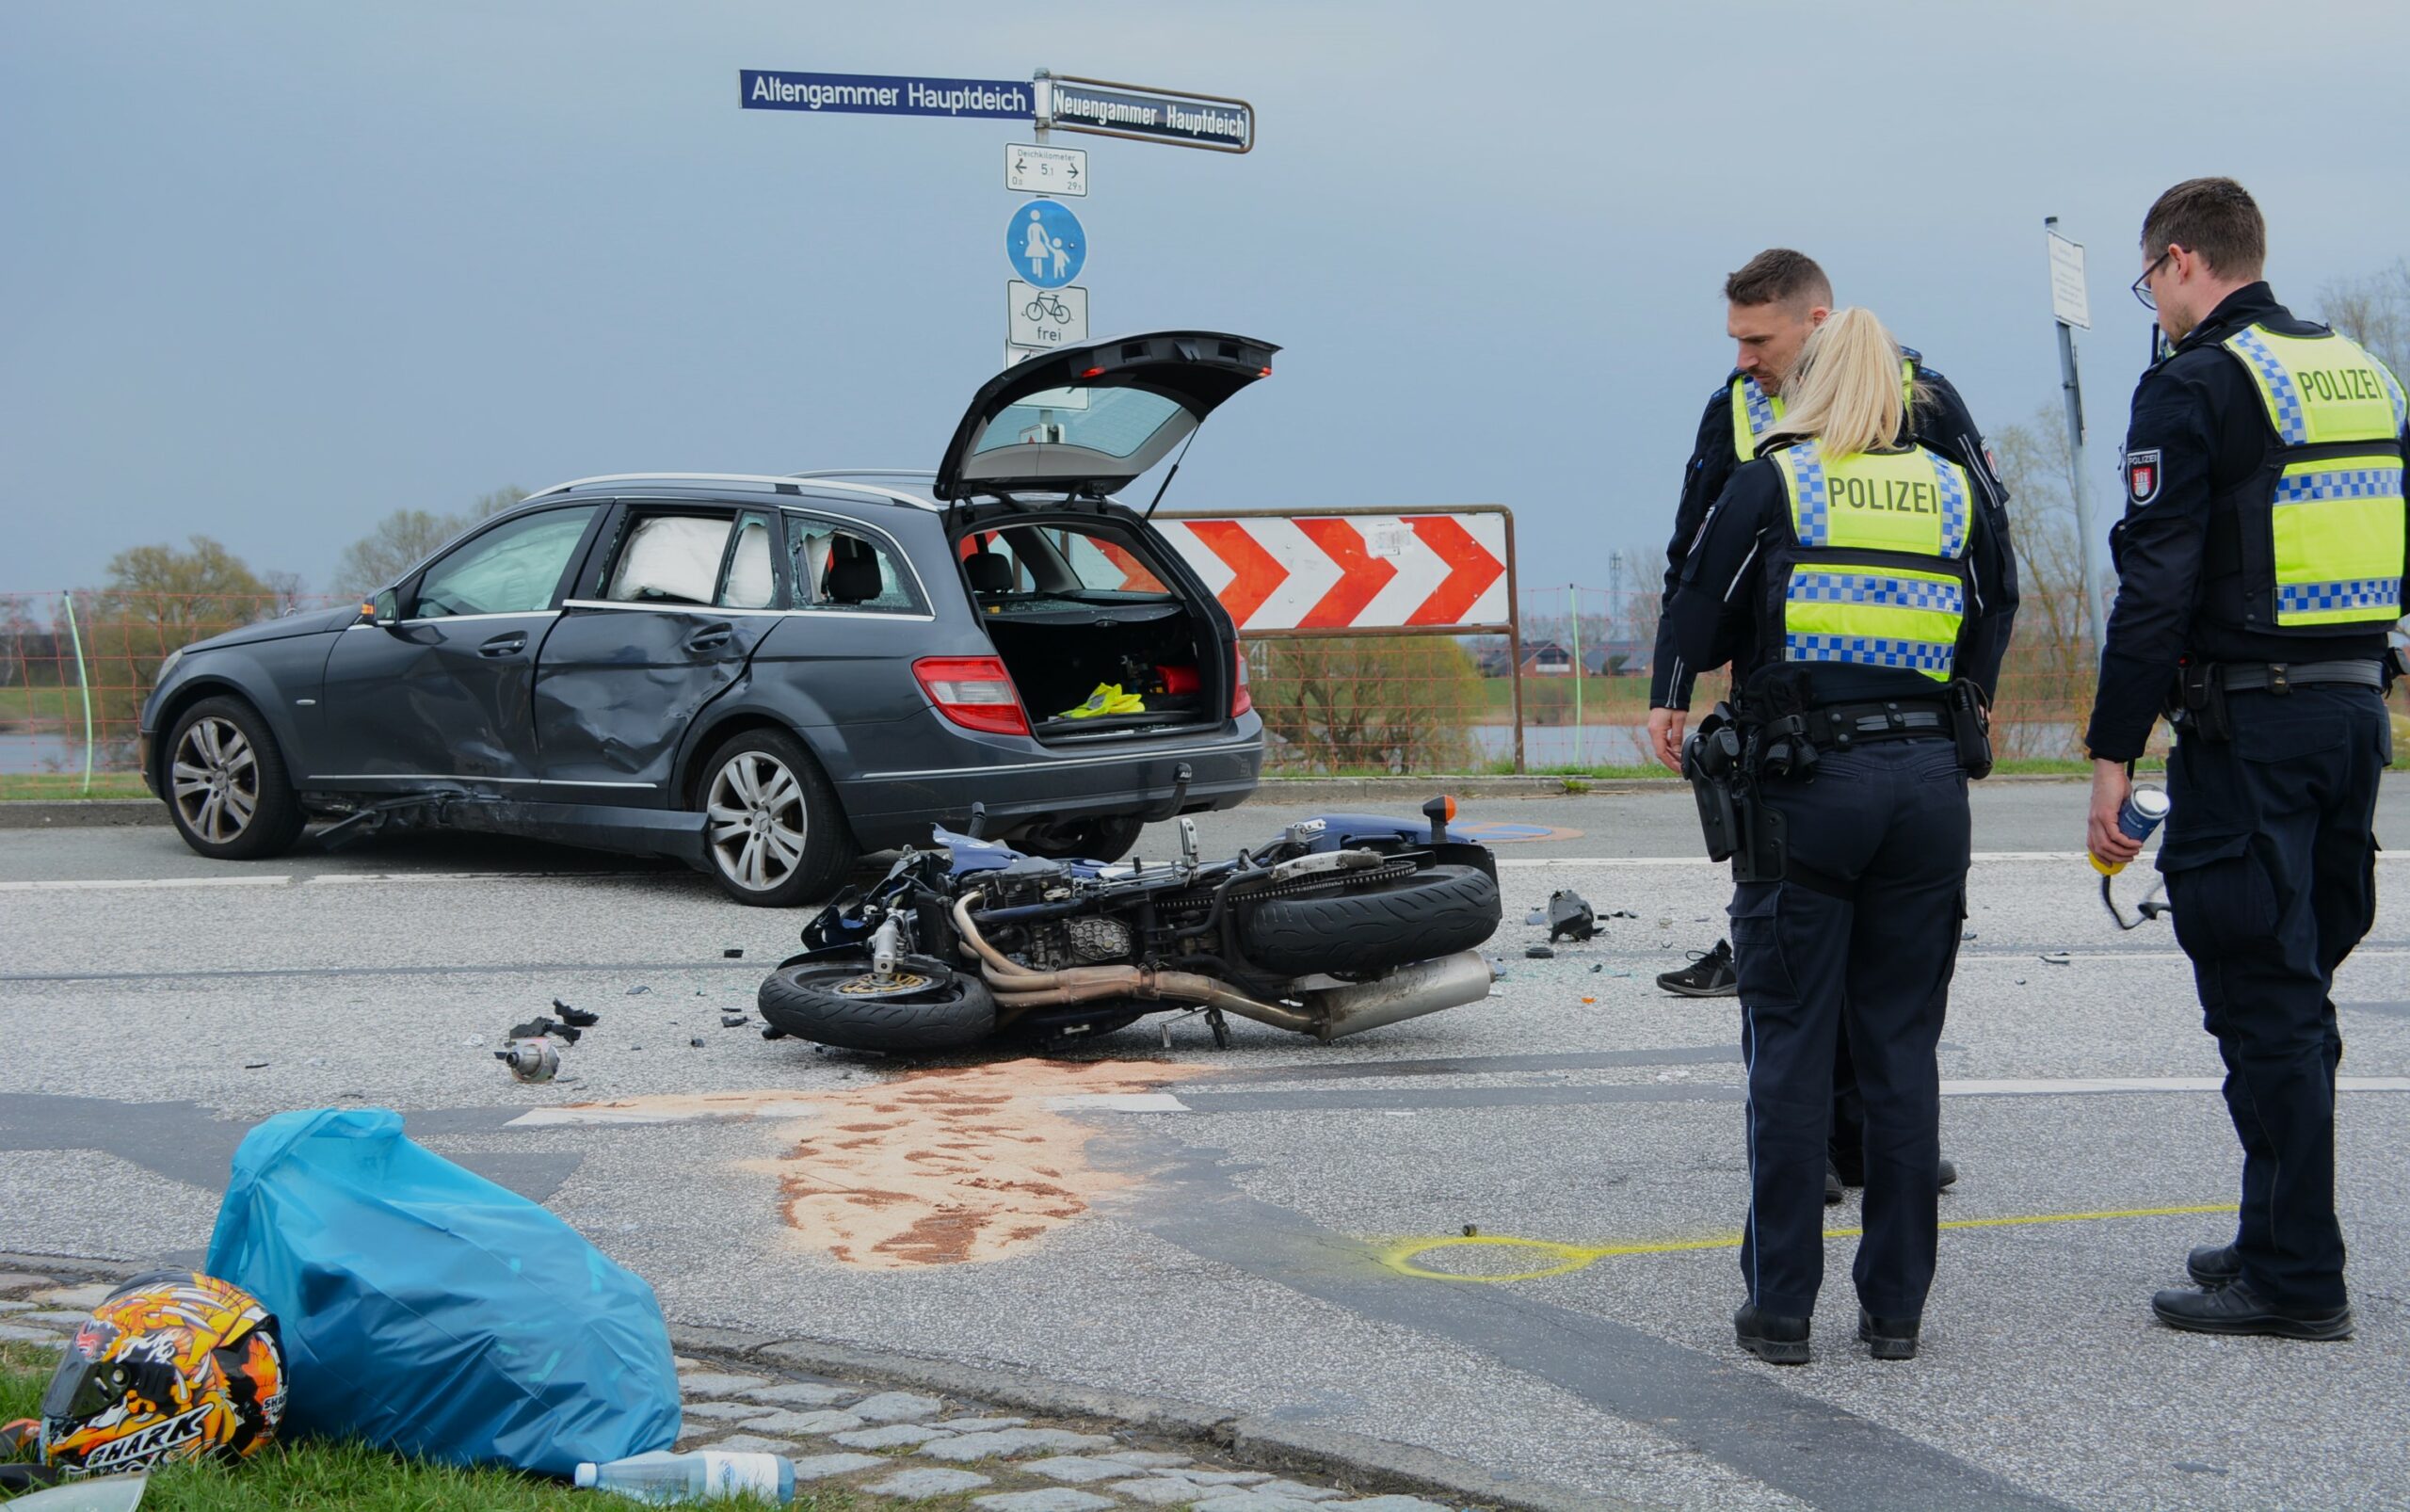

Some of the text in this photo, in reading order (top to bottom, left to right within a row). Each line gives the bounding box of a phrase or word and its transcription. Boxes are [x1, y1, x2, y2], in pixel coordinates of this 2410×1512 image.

[751, 75, 1026, 115] Altengammer Hauptdeich
[1052, 88, 1245, 137] Neuengammer Hauptdeich
[1018, 149, 1075, 161] Deichkilometer
[1036, 326, 1062, 342] frei
[2297, 369, 2384, 403] POLIZEI
[2129, 454, 2157, 466] POLIZEI
[1827, 476, 1937, 514] POLIZEI
[87, 1404, 211, 1467] SHARK
